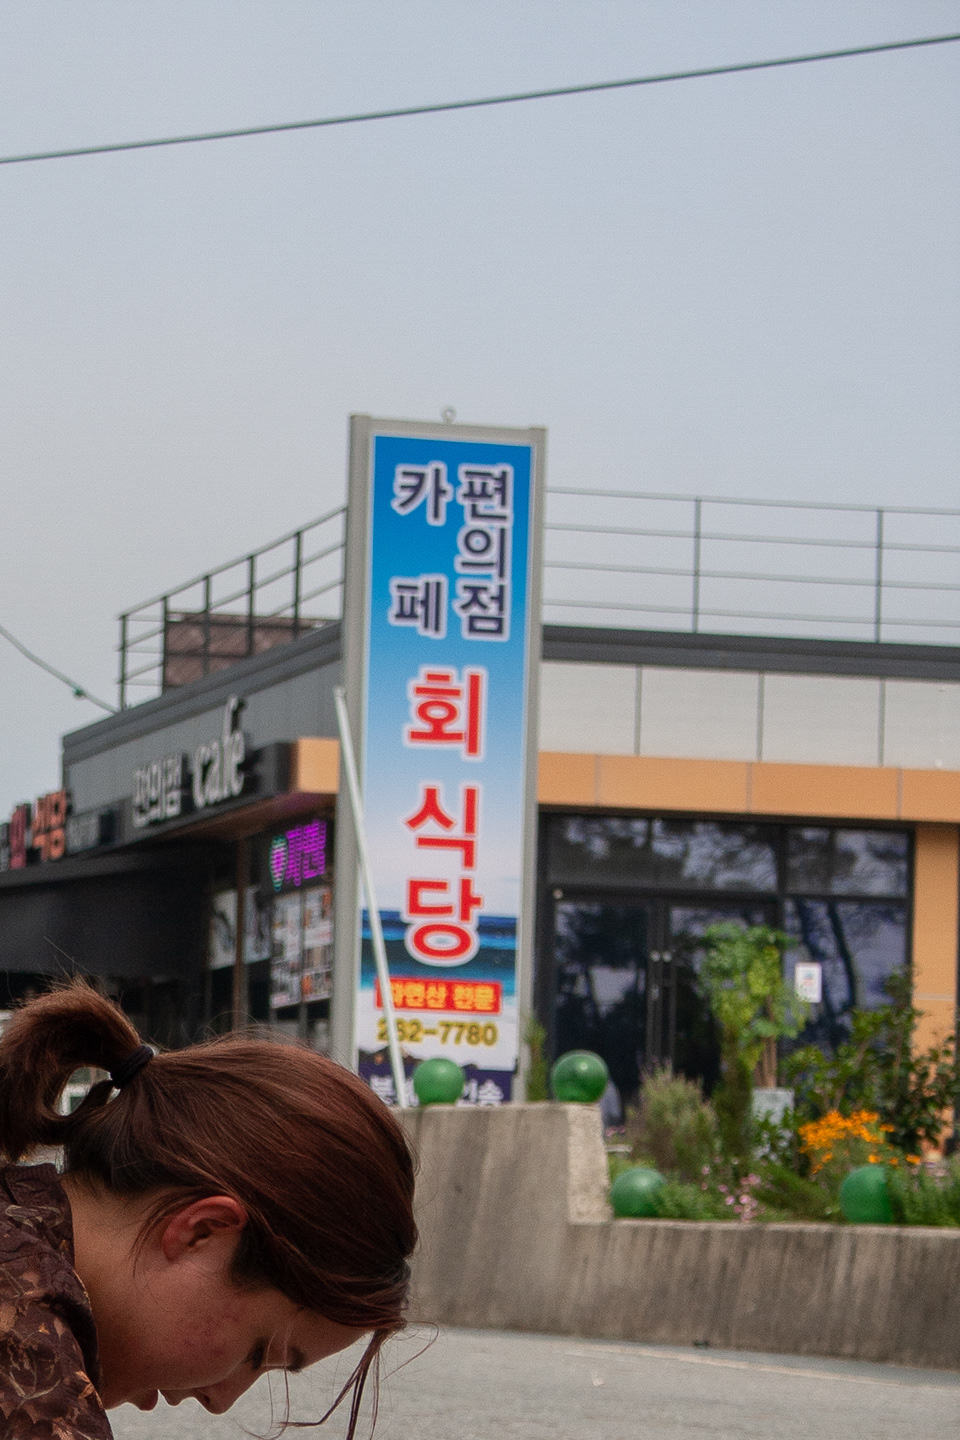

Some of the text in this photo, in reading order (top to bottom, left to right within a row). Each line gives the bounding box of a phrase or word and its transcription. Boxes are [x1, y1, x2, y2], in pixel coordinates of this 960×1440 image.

[392, 464, 451, 637] 카페
[456, 466, 512, 639] 편의점
[192, 694, 245, 808] cafe
[404, 669, 485, 962] 회식당
